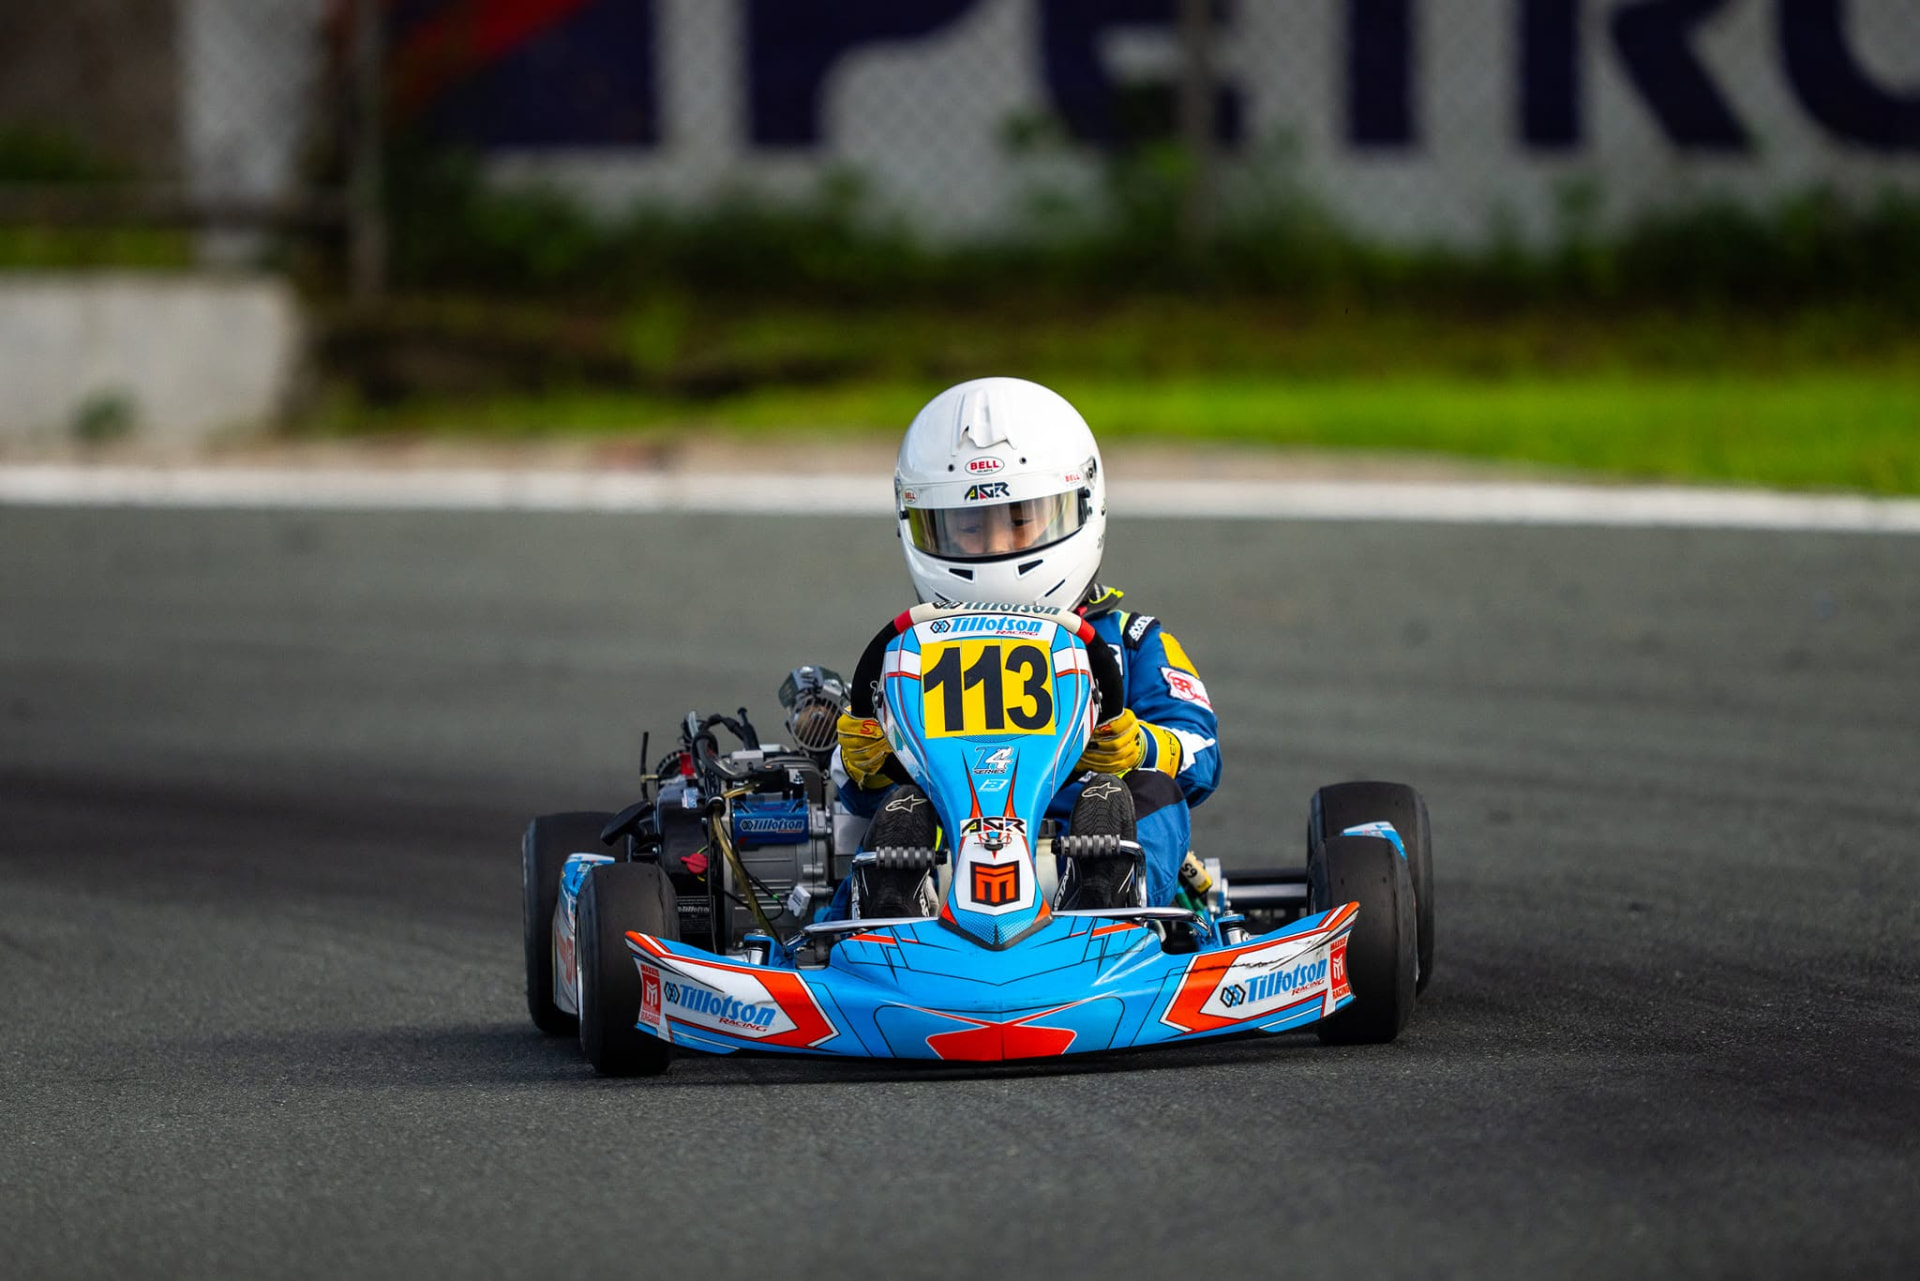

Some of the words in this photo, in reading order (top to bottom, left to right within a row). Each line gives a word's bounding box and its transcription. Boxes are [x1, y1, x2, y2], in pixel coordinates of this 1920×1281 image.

[970, 460, 1000, 471] BELL
[950, 616, 1044, 633] Tillotson
[923, 645, 1054, 732] 113
[975, 744, 1014, 770] T4
[752, 818, 805, 832] Tillotson
[1244, 957, 1328, 1003] Tillotson
[1291, 977, 1326, 996] RACING
[678, 983, 777, 1028] Tillotson
[718, 1017, 770, 1033] RACING
